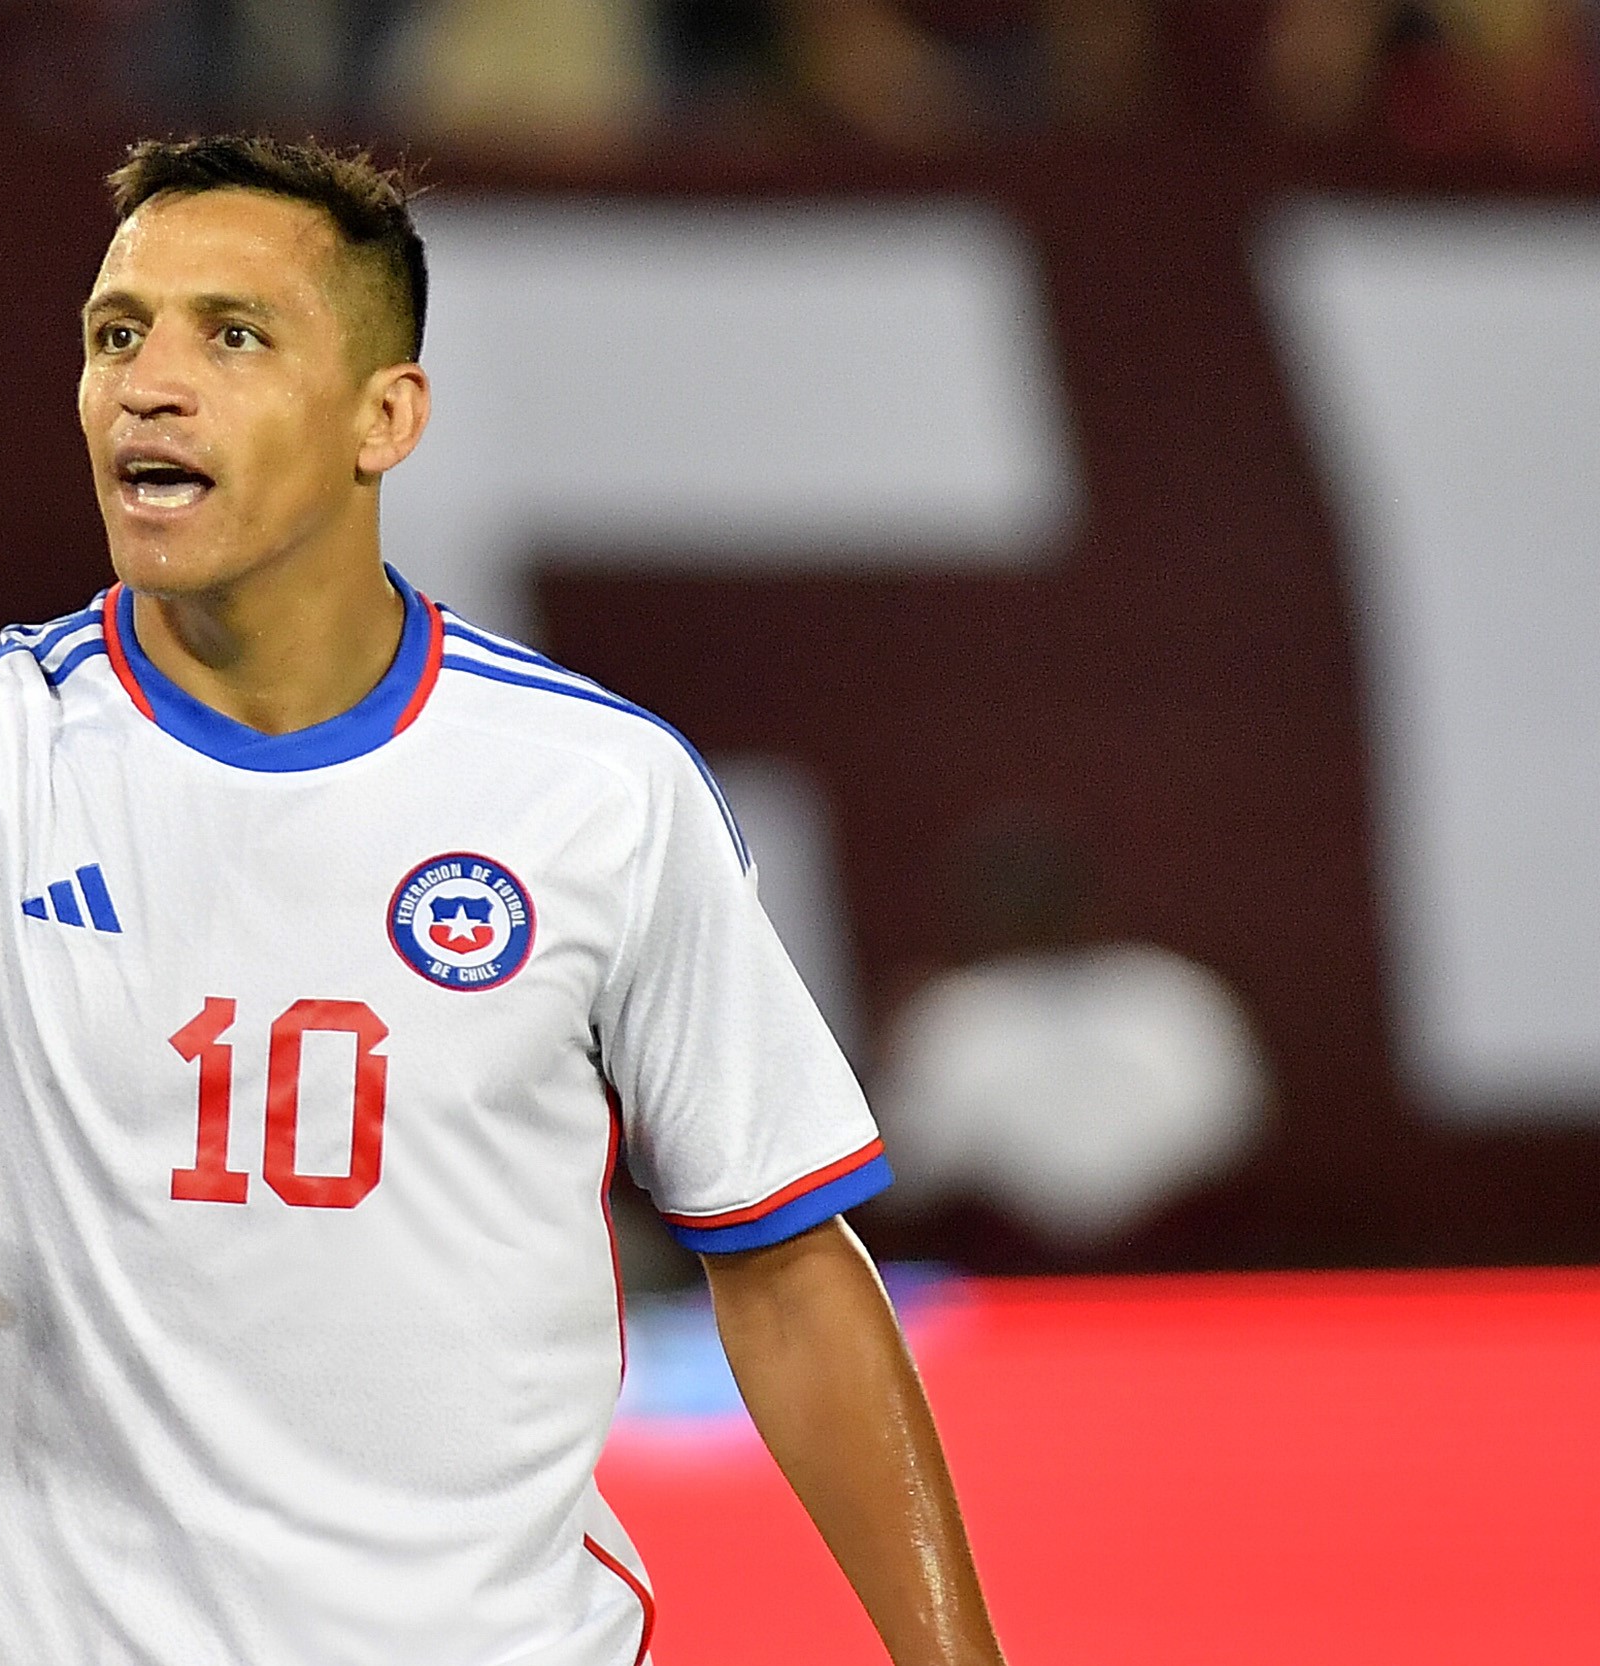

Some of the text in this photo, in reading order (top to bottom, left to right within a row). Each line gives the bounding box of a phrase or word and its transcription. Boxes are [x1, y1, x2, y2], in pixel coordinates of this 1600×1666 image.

[397, 863, 526, 927] FEDERACION DE FUTBOL
[459, 964, 498, 982] CHILE
[168, 996, 388, 1208] 10
